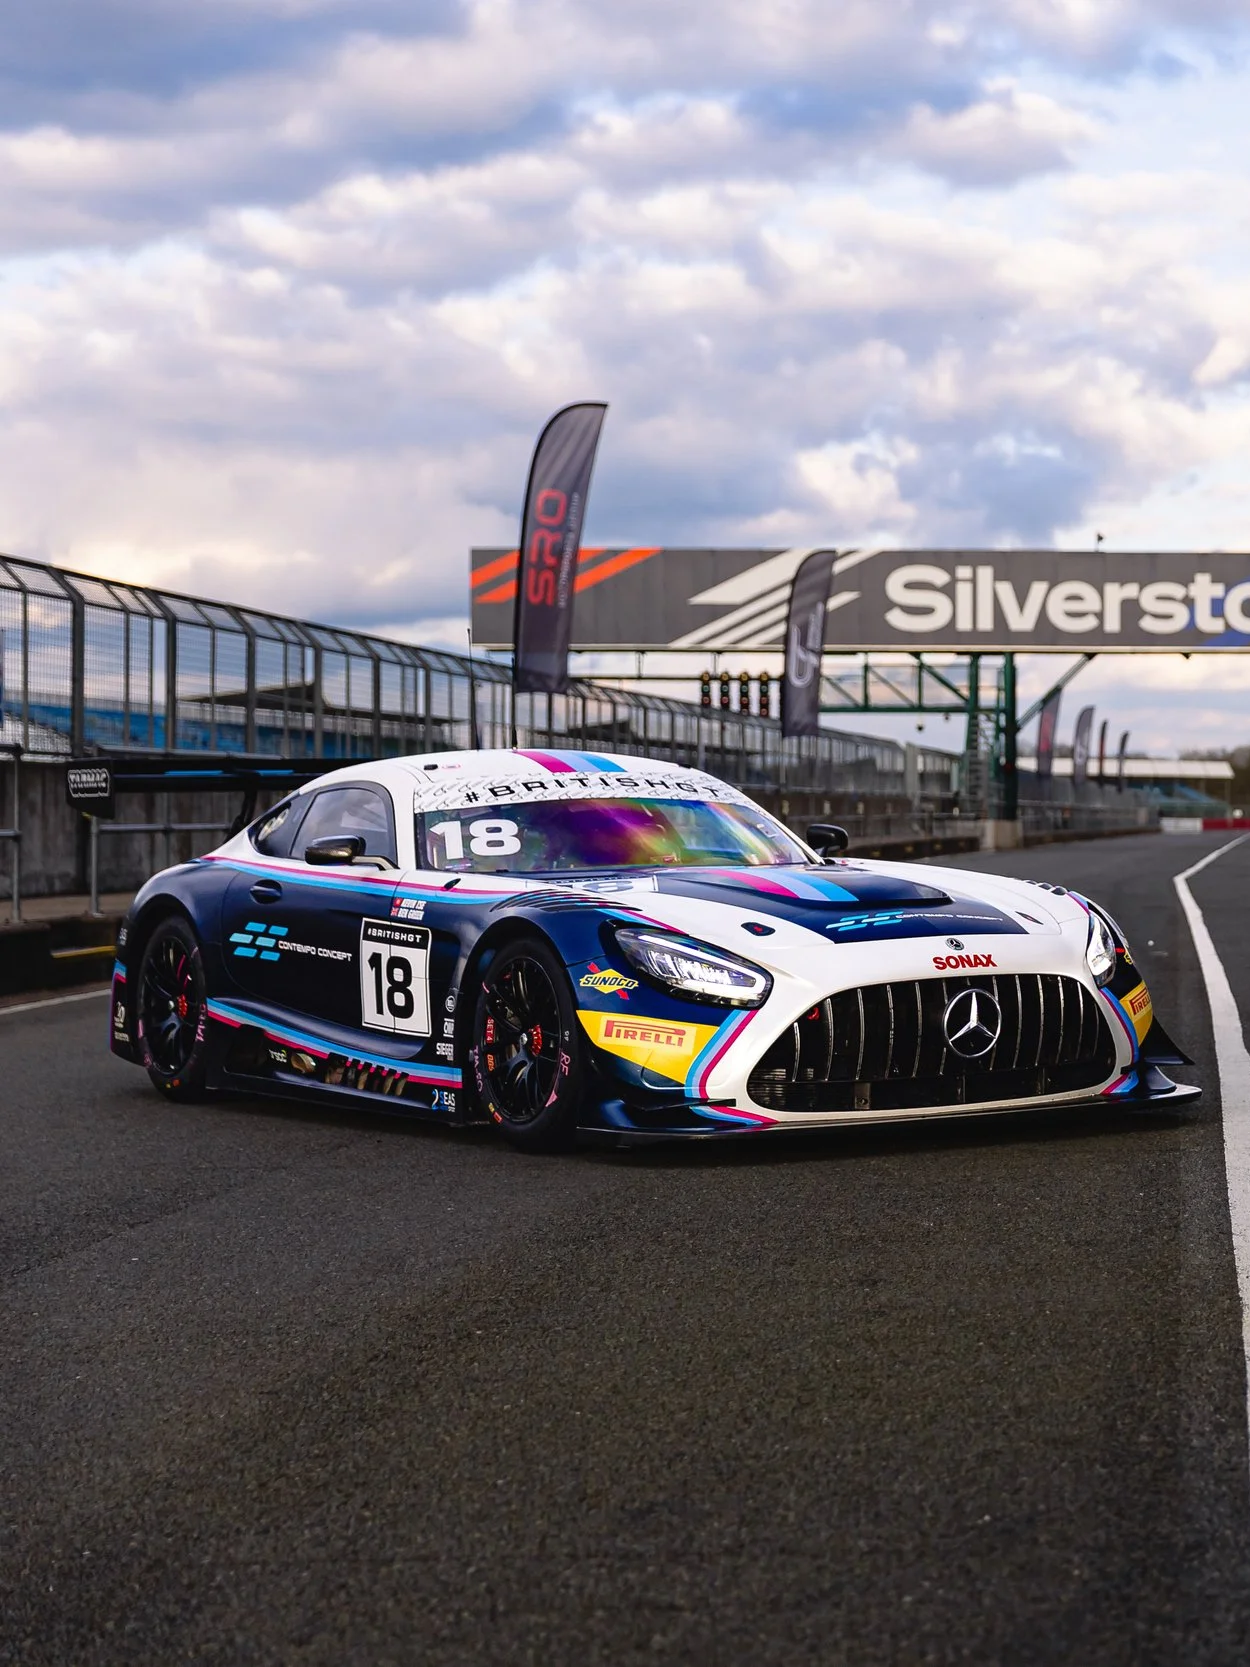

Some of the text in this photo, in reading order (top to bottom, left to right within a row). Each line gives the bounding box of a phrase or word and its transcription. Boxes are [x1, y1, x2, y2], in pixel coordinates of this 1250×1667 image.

[527, 488, 567, 606] SRO
[464, 777, 720, 803] #BRITISHGT
[429, 818, 522, 860] 18
[367, 927, 422, 943] #BRITISHGT
[278, 940, 352, 962] CONTEMPO CONCEPT
[932, 954, 998, 971] SONAX
[367, 952, 415, 1019] 18
[582, 975, 636, 989] SUNOCO
[486, 1018, 494, 1033] SET
[604, 1019, 686, 1047] PIRELLI
[440, 1090, 455, 1106] SEAS
